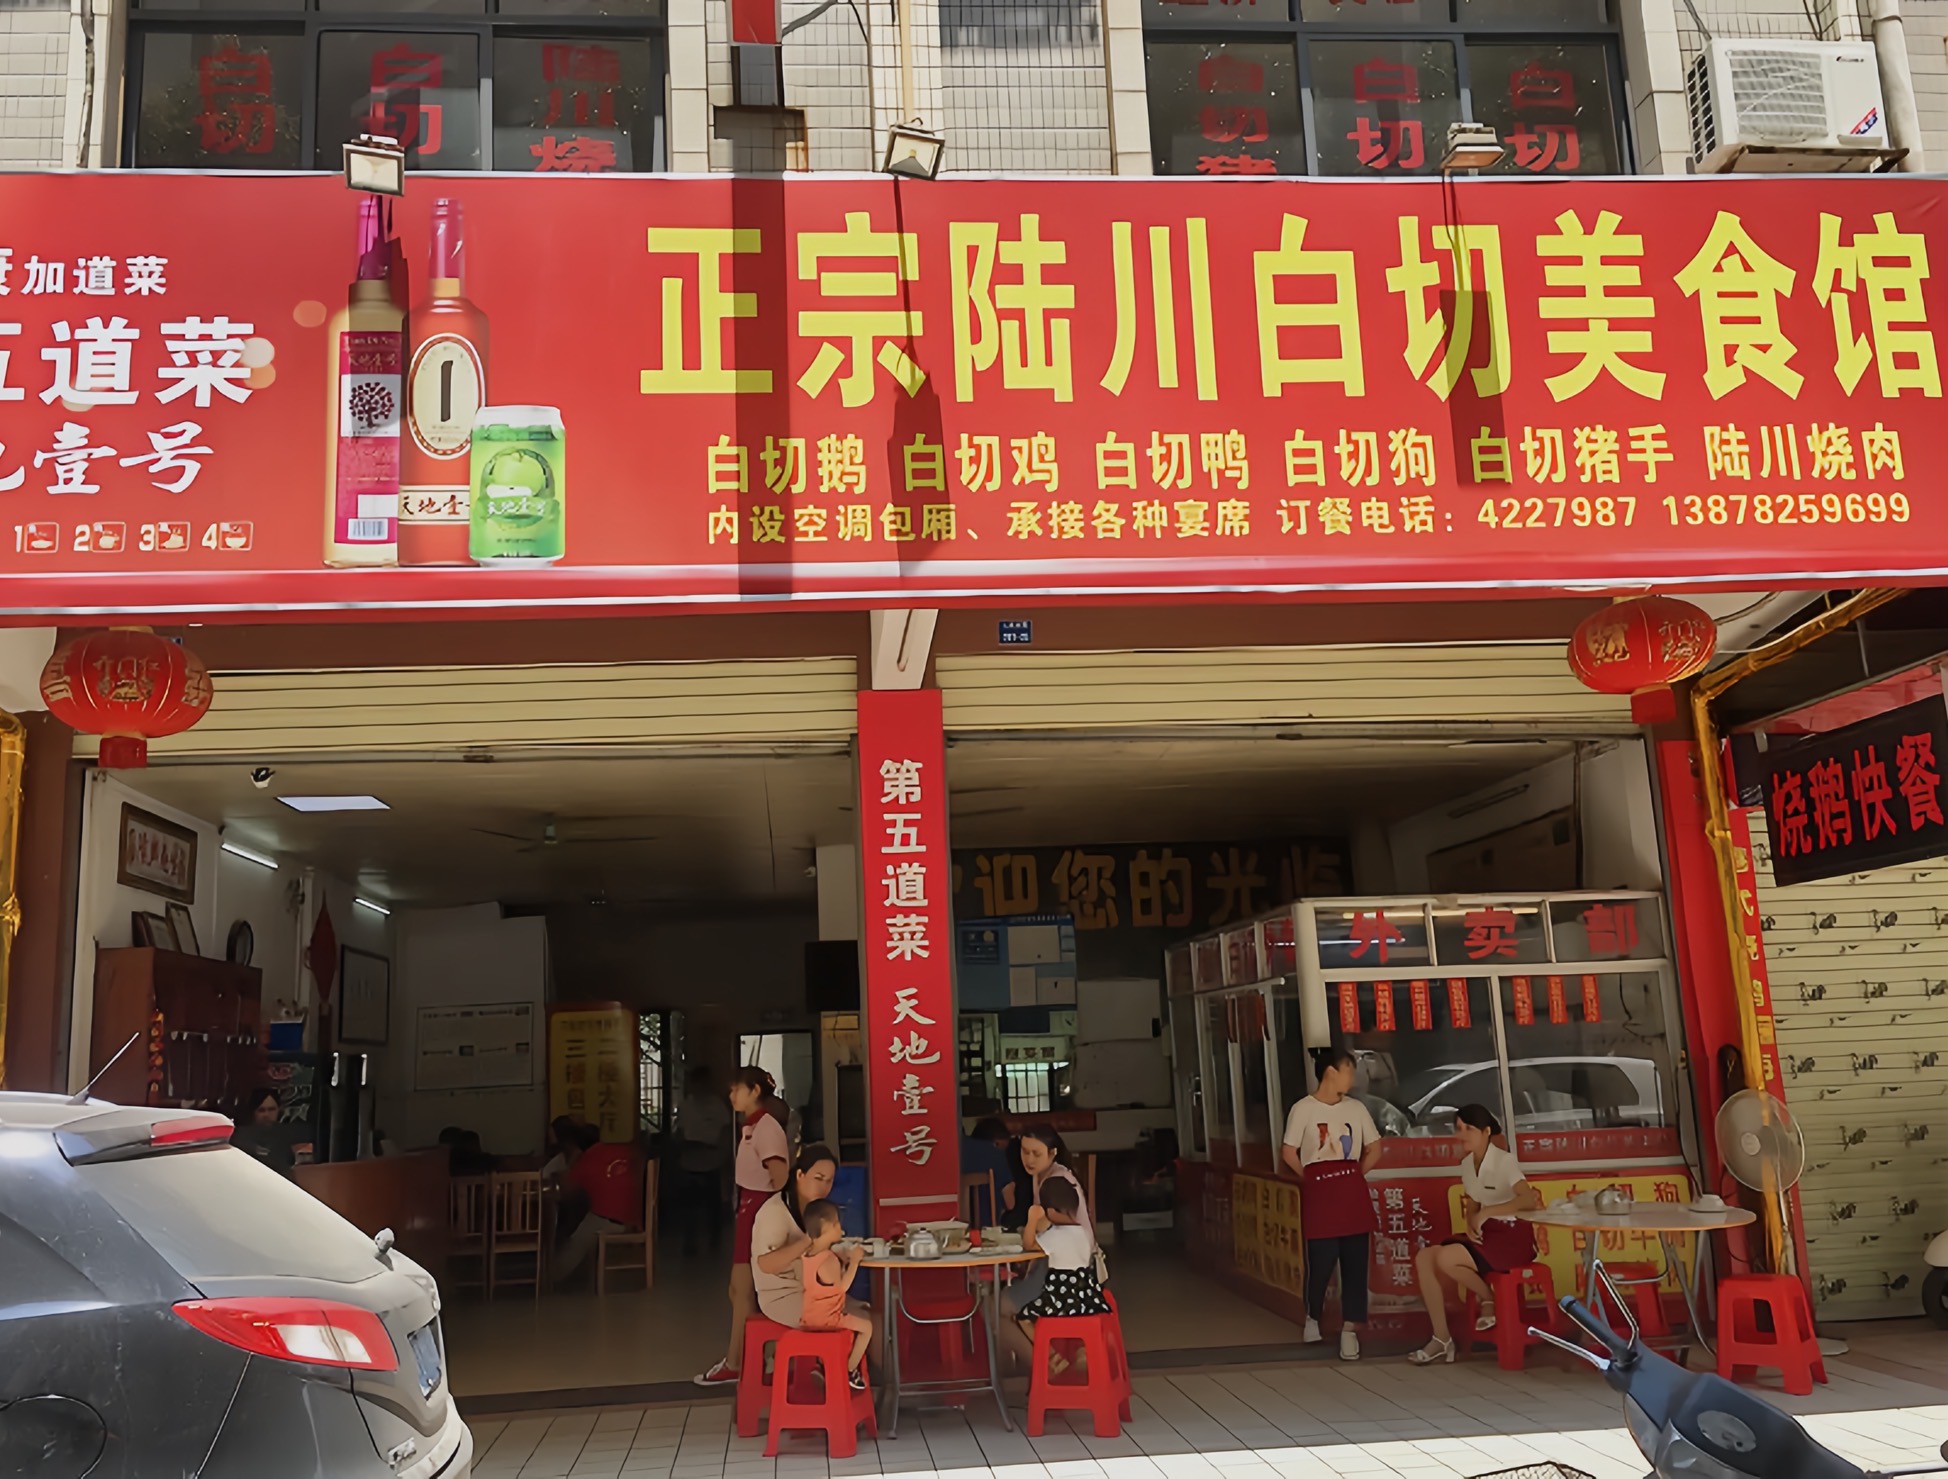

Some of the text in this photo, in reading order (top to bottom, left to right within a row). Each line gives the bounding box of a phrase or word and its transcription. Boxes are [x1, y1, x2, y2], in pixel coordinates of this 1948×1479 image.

[1346, 58, 1425, 170] 白切
[1503, 60, 1582, 171] 白切
[640, 208, 1943, 408] 正宗陆川白切美食馆
[401, 494, 470, 516] 天地壹
[707, 422, 1905, 495] 白切鹅 白切鸡 白切鸭 白切狗 白切猪手 陆川烧肉
[73, 524, 91, 552] 2
[138, 523, 156, 551] 3
[201, 523, 218, 550] 4
[1477, 496, 1637, 529] 4227987
[1662, 493, 1911, 526] 13878259699
[1772, 732, 1944, 857] 烧鹅快餐
[879, 759, 930, 961] 第五道菜
[953, 846, 1342, 930] 迎您的光临
[1349, 903, 1640, 965] 外卖部
[888, 987, 941, 1167] 天地壹号
[1384, 1187, 1413, 1287] 第五道菜
